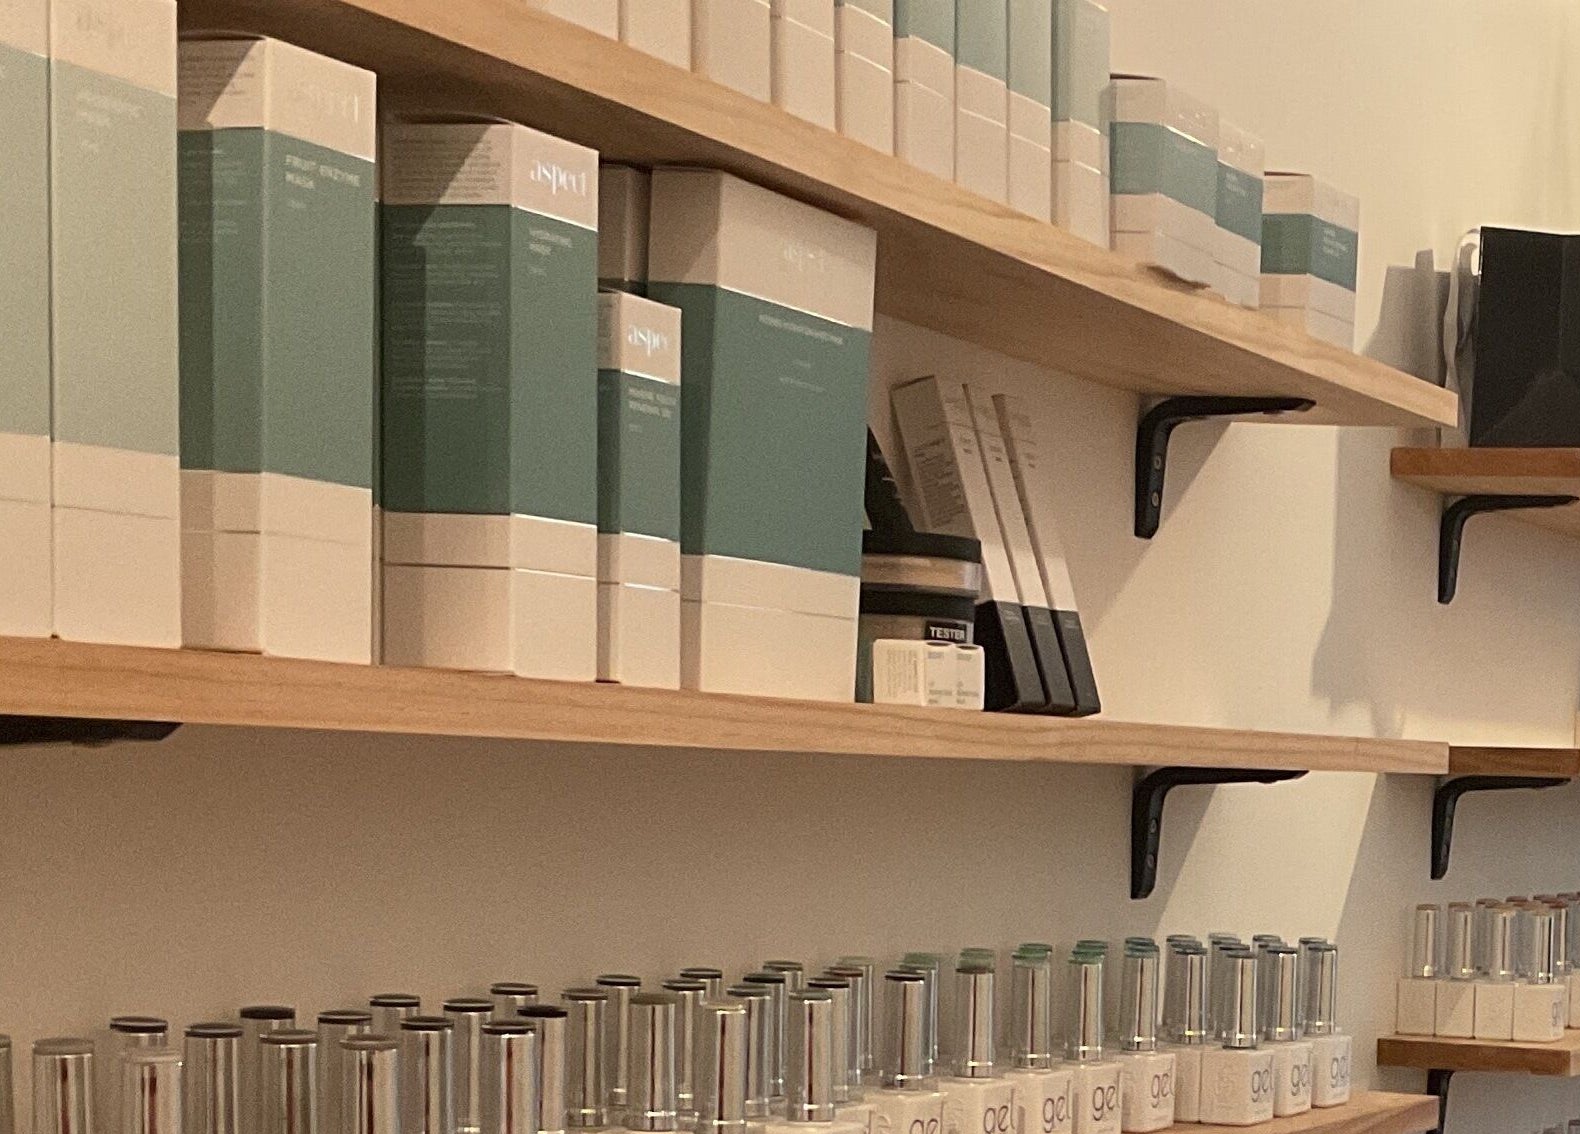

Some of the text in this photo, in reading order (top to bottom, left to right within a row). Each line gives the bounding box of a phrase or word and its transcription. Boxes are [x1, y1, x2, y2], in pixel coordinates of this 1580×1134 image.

[530, 159, 588, 197] aspect
[929, 625, 966, 641] TESTER
[1092, 1071, 1121, 1122] gel
[1151, 1061, 1176, 1108] gel
[1252, 1054, 1276, 1102] gel
[1043, 1079, 1072, 1133] gel
